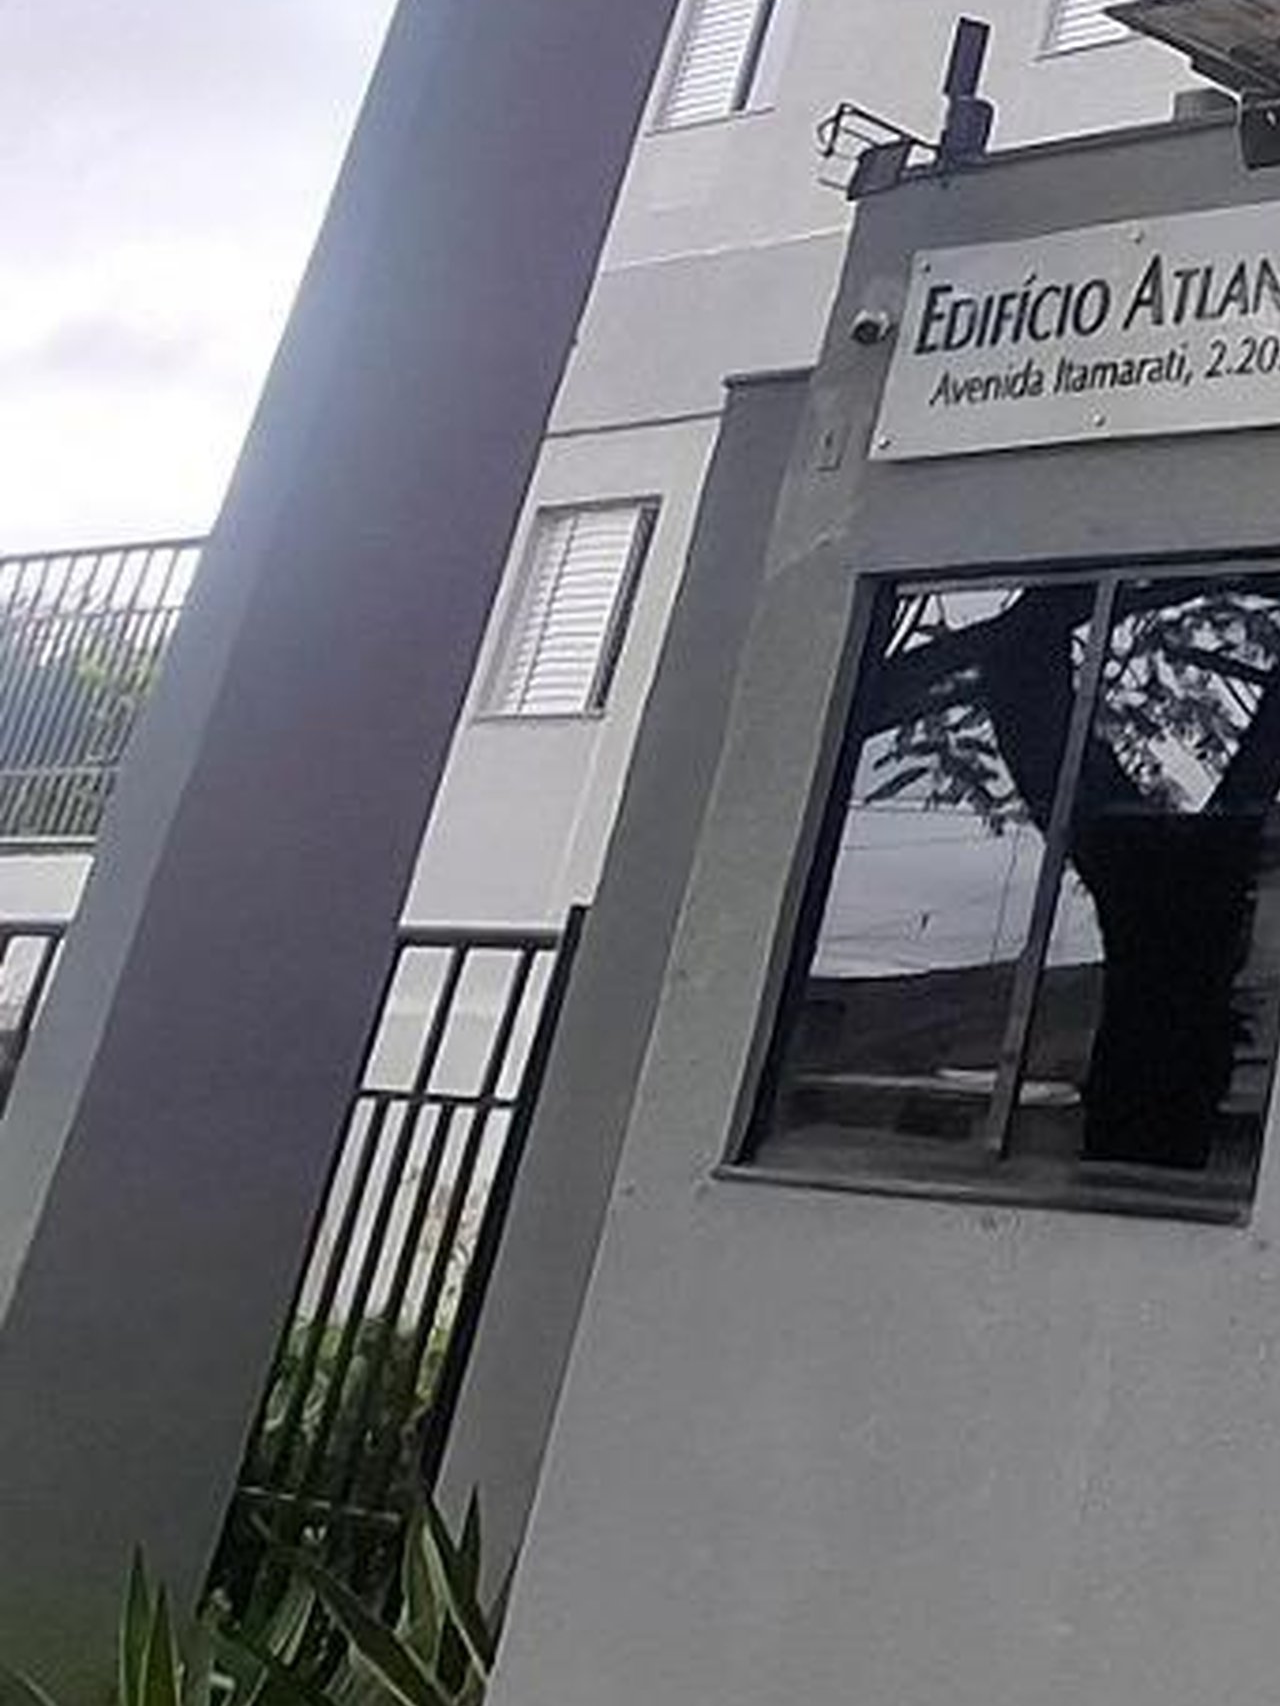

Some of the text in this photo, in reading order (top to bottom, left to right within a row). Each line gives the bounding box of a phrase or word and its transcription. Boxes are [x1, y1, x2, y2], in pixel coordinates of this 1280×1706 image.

[914, 273, 1111, 355] EDIFÍCIO
[929, 361, 1044, 407] Avenida
[1054, 343, 1193, 395] Itamarati,
